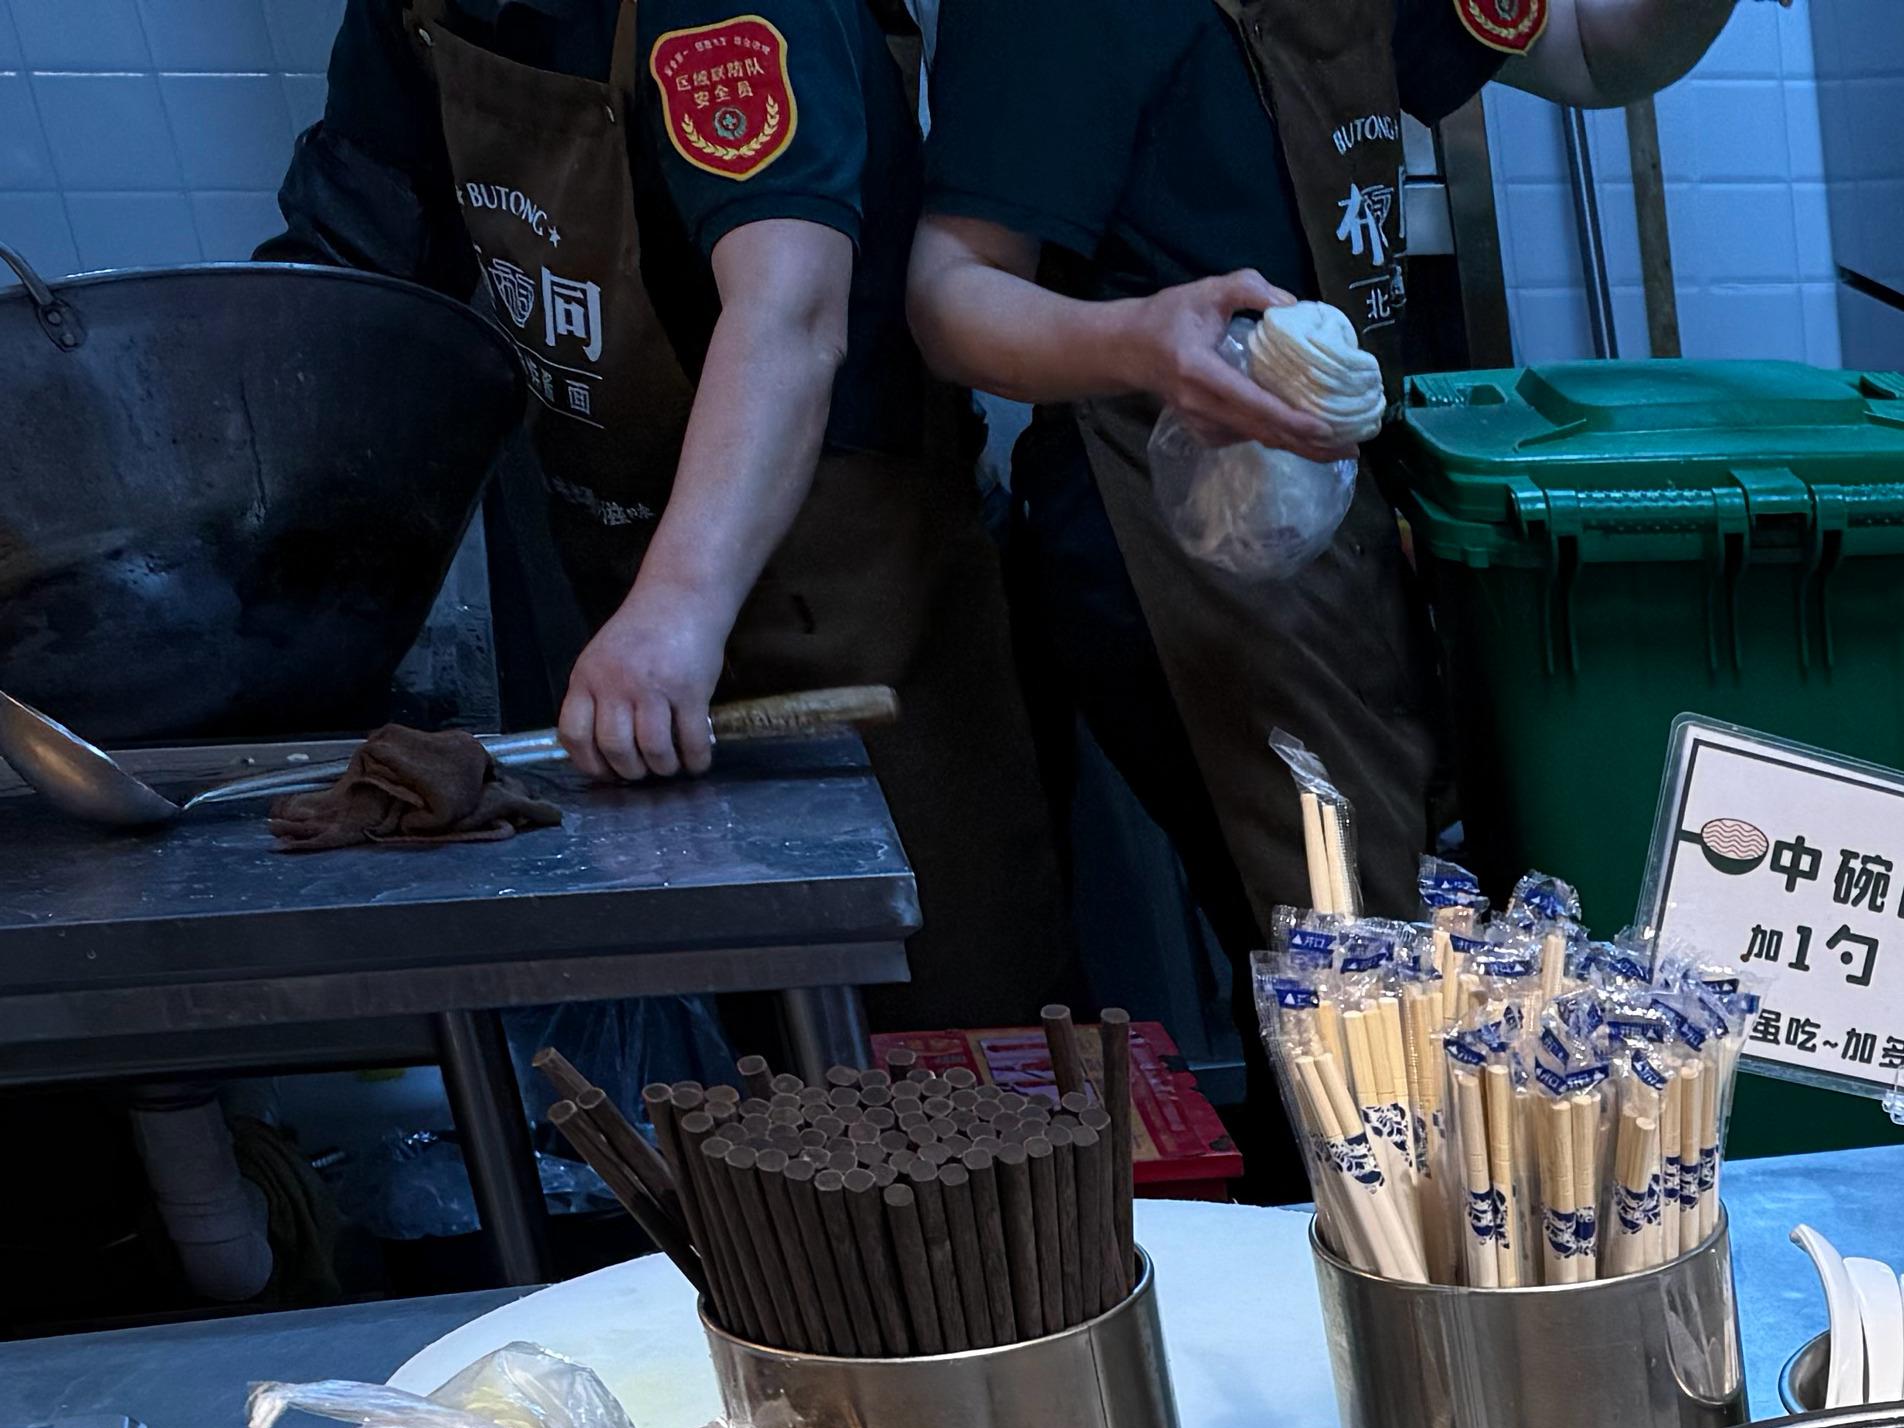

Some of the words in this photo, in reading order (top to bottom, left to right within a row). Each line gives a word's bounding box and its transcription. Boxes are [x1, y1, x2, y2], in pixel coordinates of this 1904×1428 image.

[694, 80, 753, 108] 安全员
[466, 182, 547, 237] BUTONG
[541, 265, 601, 362] 同
[1747, 923, 1880, 988] 加1勺
